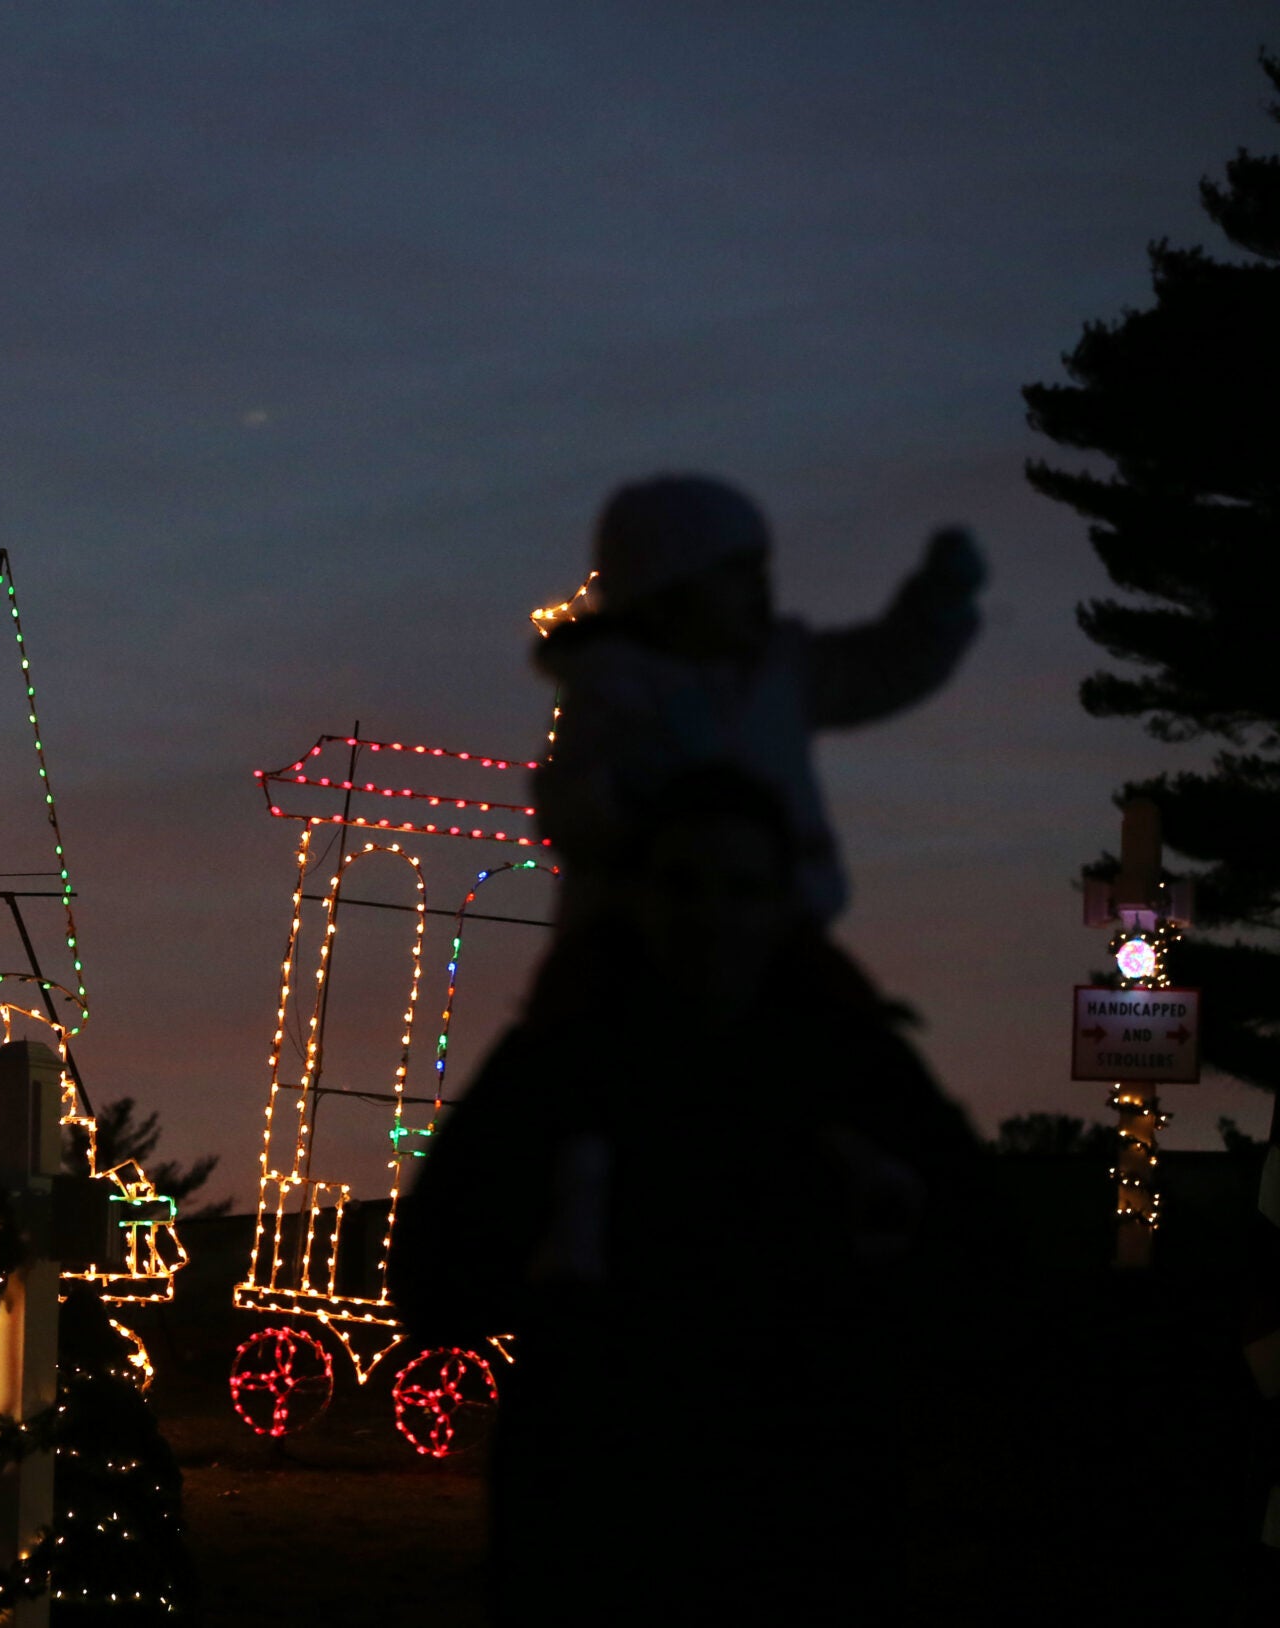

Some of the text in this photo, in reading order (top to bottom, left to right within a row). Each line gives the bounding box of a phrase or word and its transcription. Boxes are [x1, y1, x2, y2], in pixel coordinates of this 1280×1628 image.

[1088, 1002, 1186, 1017] HANDICAPPED
[1122, 1029, 1152, 1042] AND
[1097, 1052, 1174, 1067] STROLLERS
